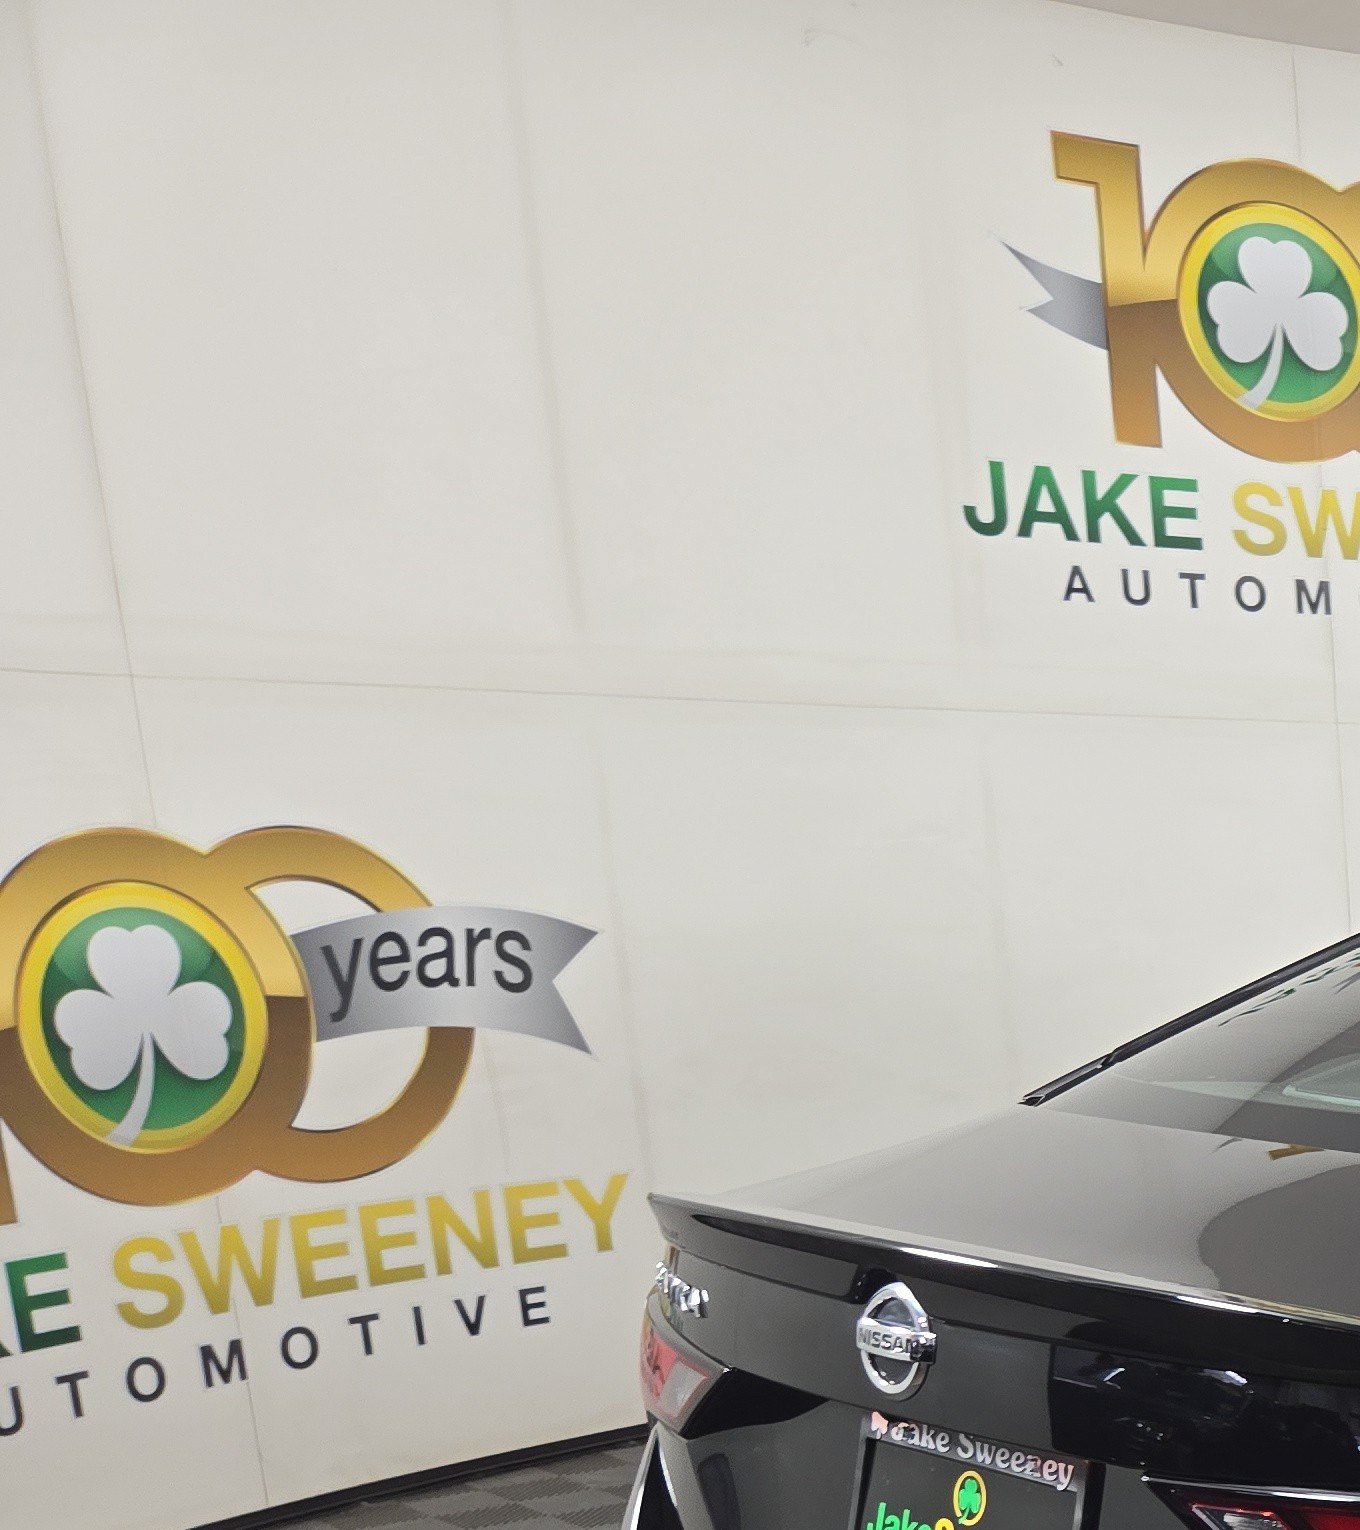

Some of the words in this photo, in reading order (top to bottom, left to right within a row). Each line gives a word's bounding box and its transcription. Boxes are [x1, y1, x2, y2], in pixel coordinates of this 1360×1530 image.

[962, 460, 1203, 551] JAKE
[0, 825, 475, 1225] 00
[321, 926, 532, 1022] years
[113, 1173, 629, 1329] SWEENEY
[0, 1286, 551, 1436] UTOMOTIVE
[890, 1421, 950, 1453] Jake
